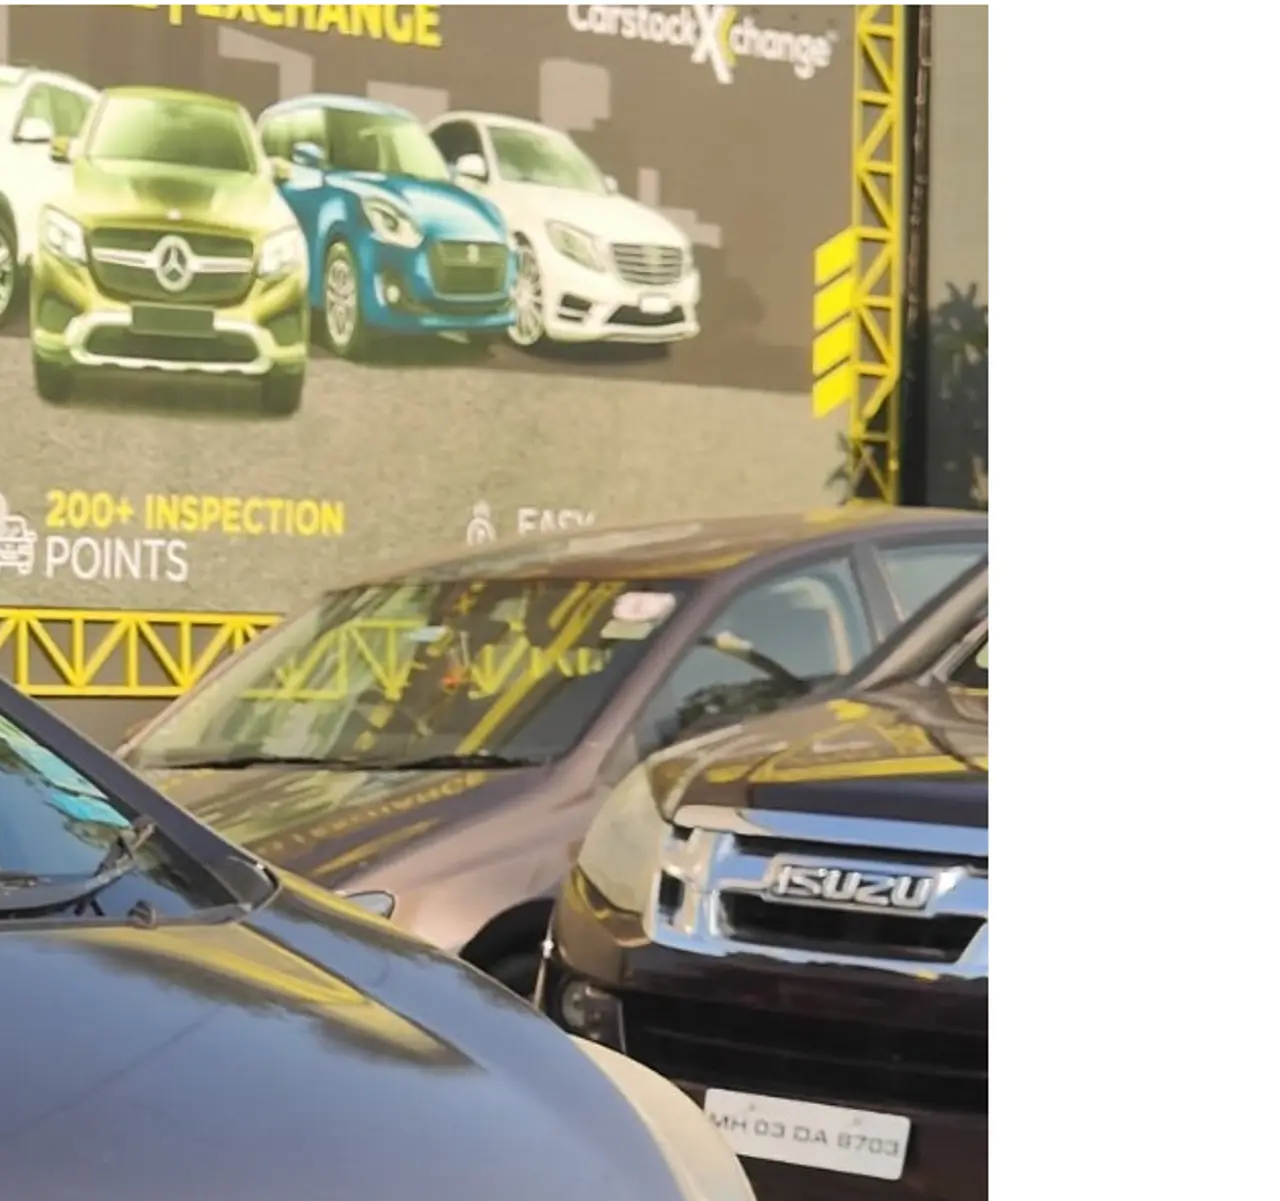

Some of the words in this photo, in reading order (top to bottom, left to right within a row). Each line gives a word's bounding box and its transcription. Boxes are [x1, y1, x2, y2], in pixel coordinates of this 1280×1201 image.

[45, 490, 134, 529] 200+
[145, 493, 345, 535] INSPECTION
[45, 535, 189, 582] POINTS
[777, 865, 934, 908] ISUZU
[792, 1125, 829, 1145] DA
